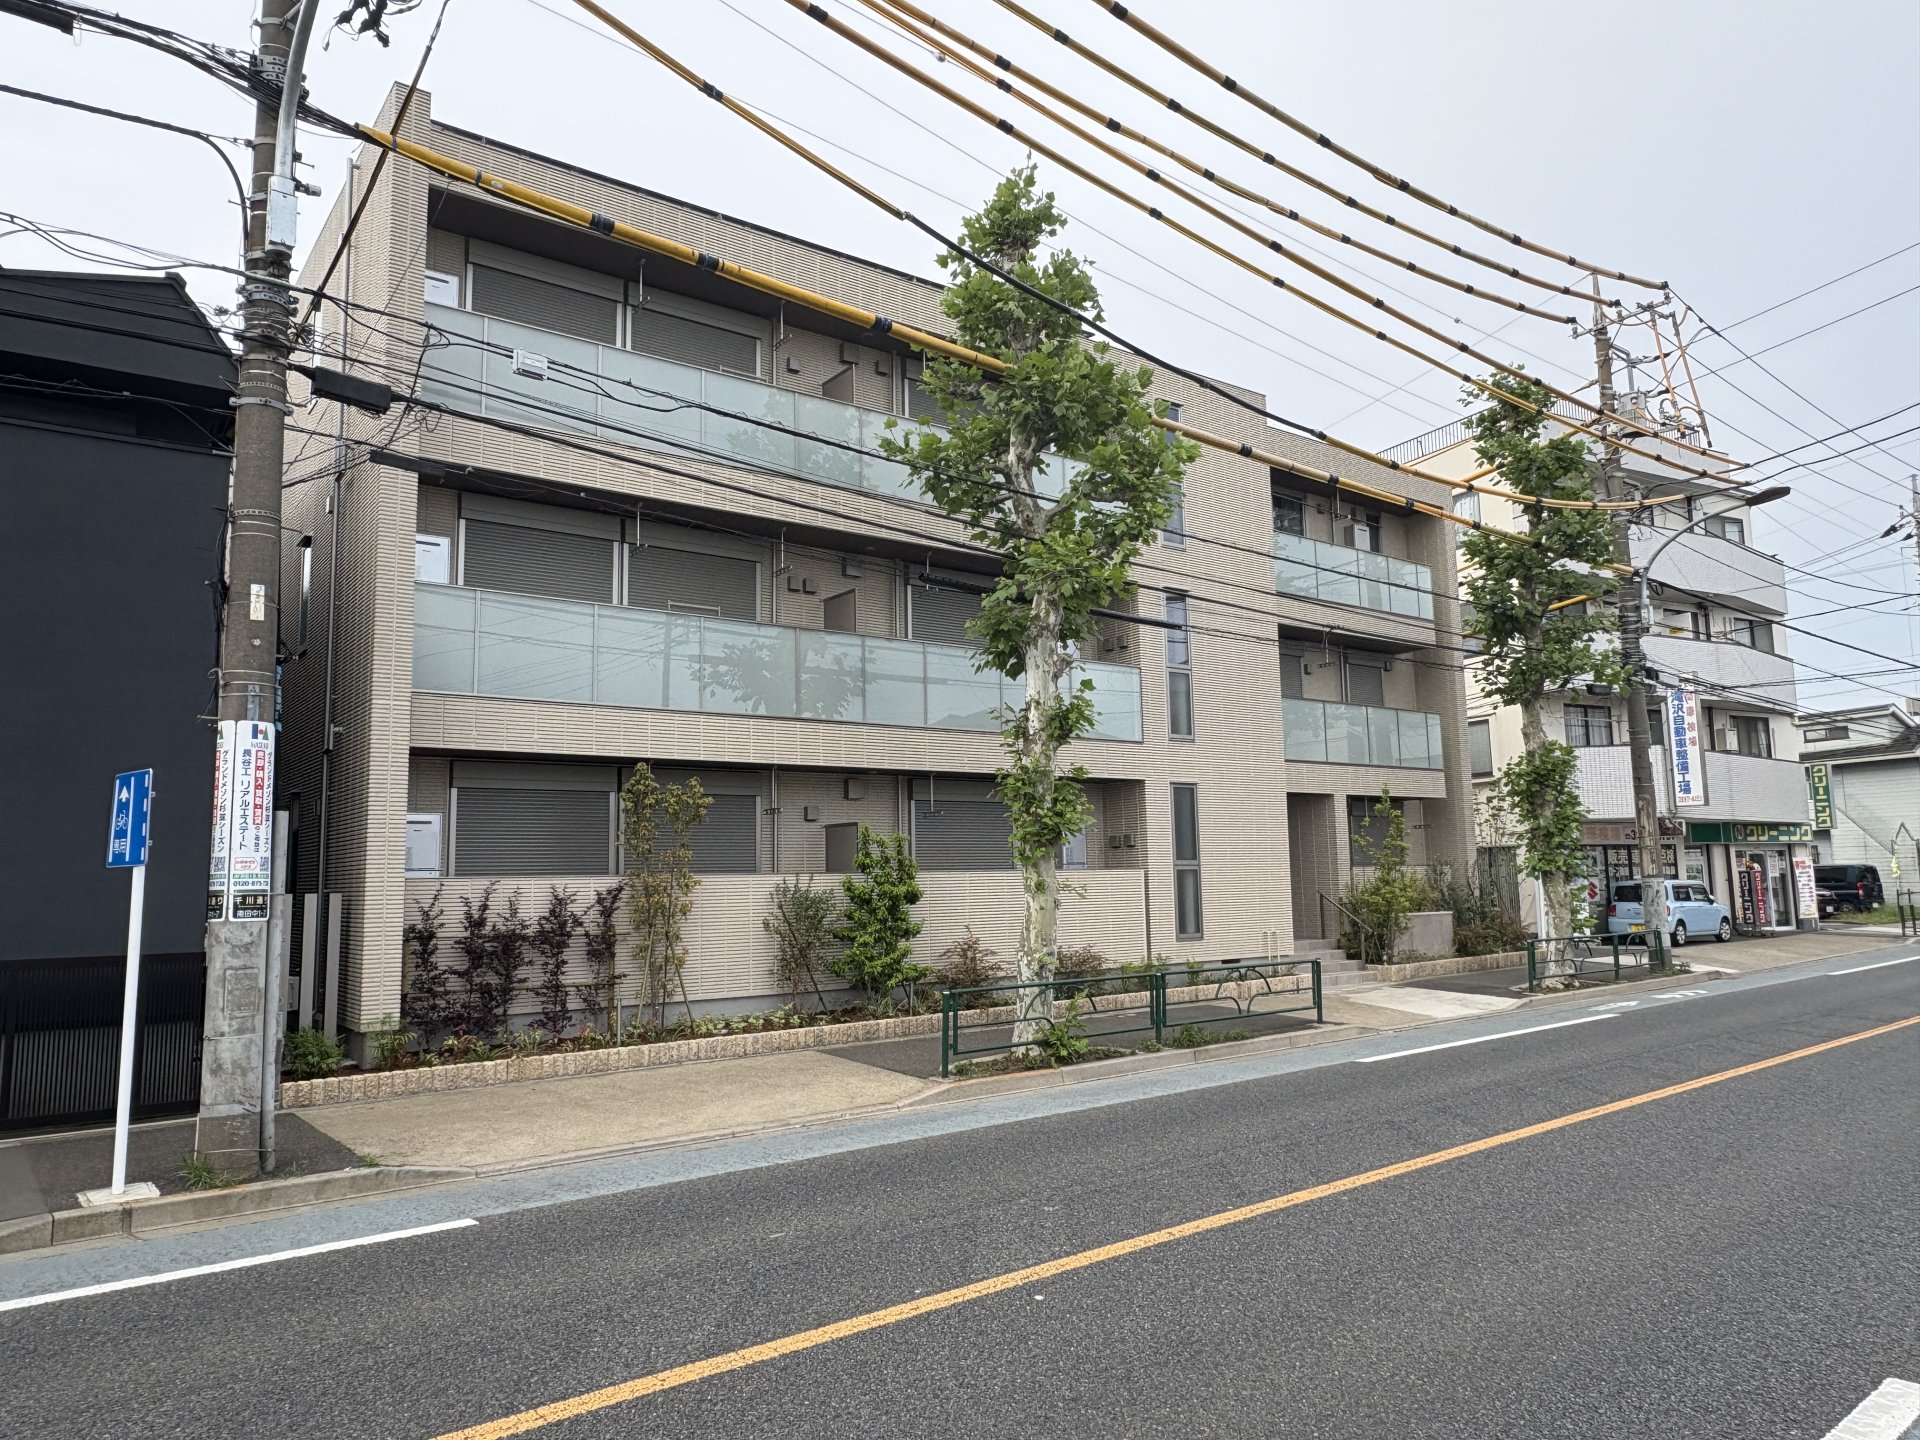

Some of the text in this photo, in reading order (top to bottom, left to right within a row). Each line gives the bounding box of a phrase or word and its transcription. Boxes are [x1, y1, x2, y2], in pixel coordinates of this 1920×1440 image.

[1812, 765, 1832, 828] クリーニング
[1746, 825, 1813, 841] クリーニング
[1740, 873, 1754, 923] クリーニング
[1754, 870, 1766, 923] クリーニング
